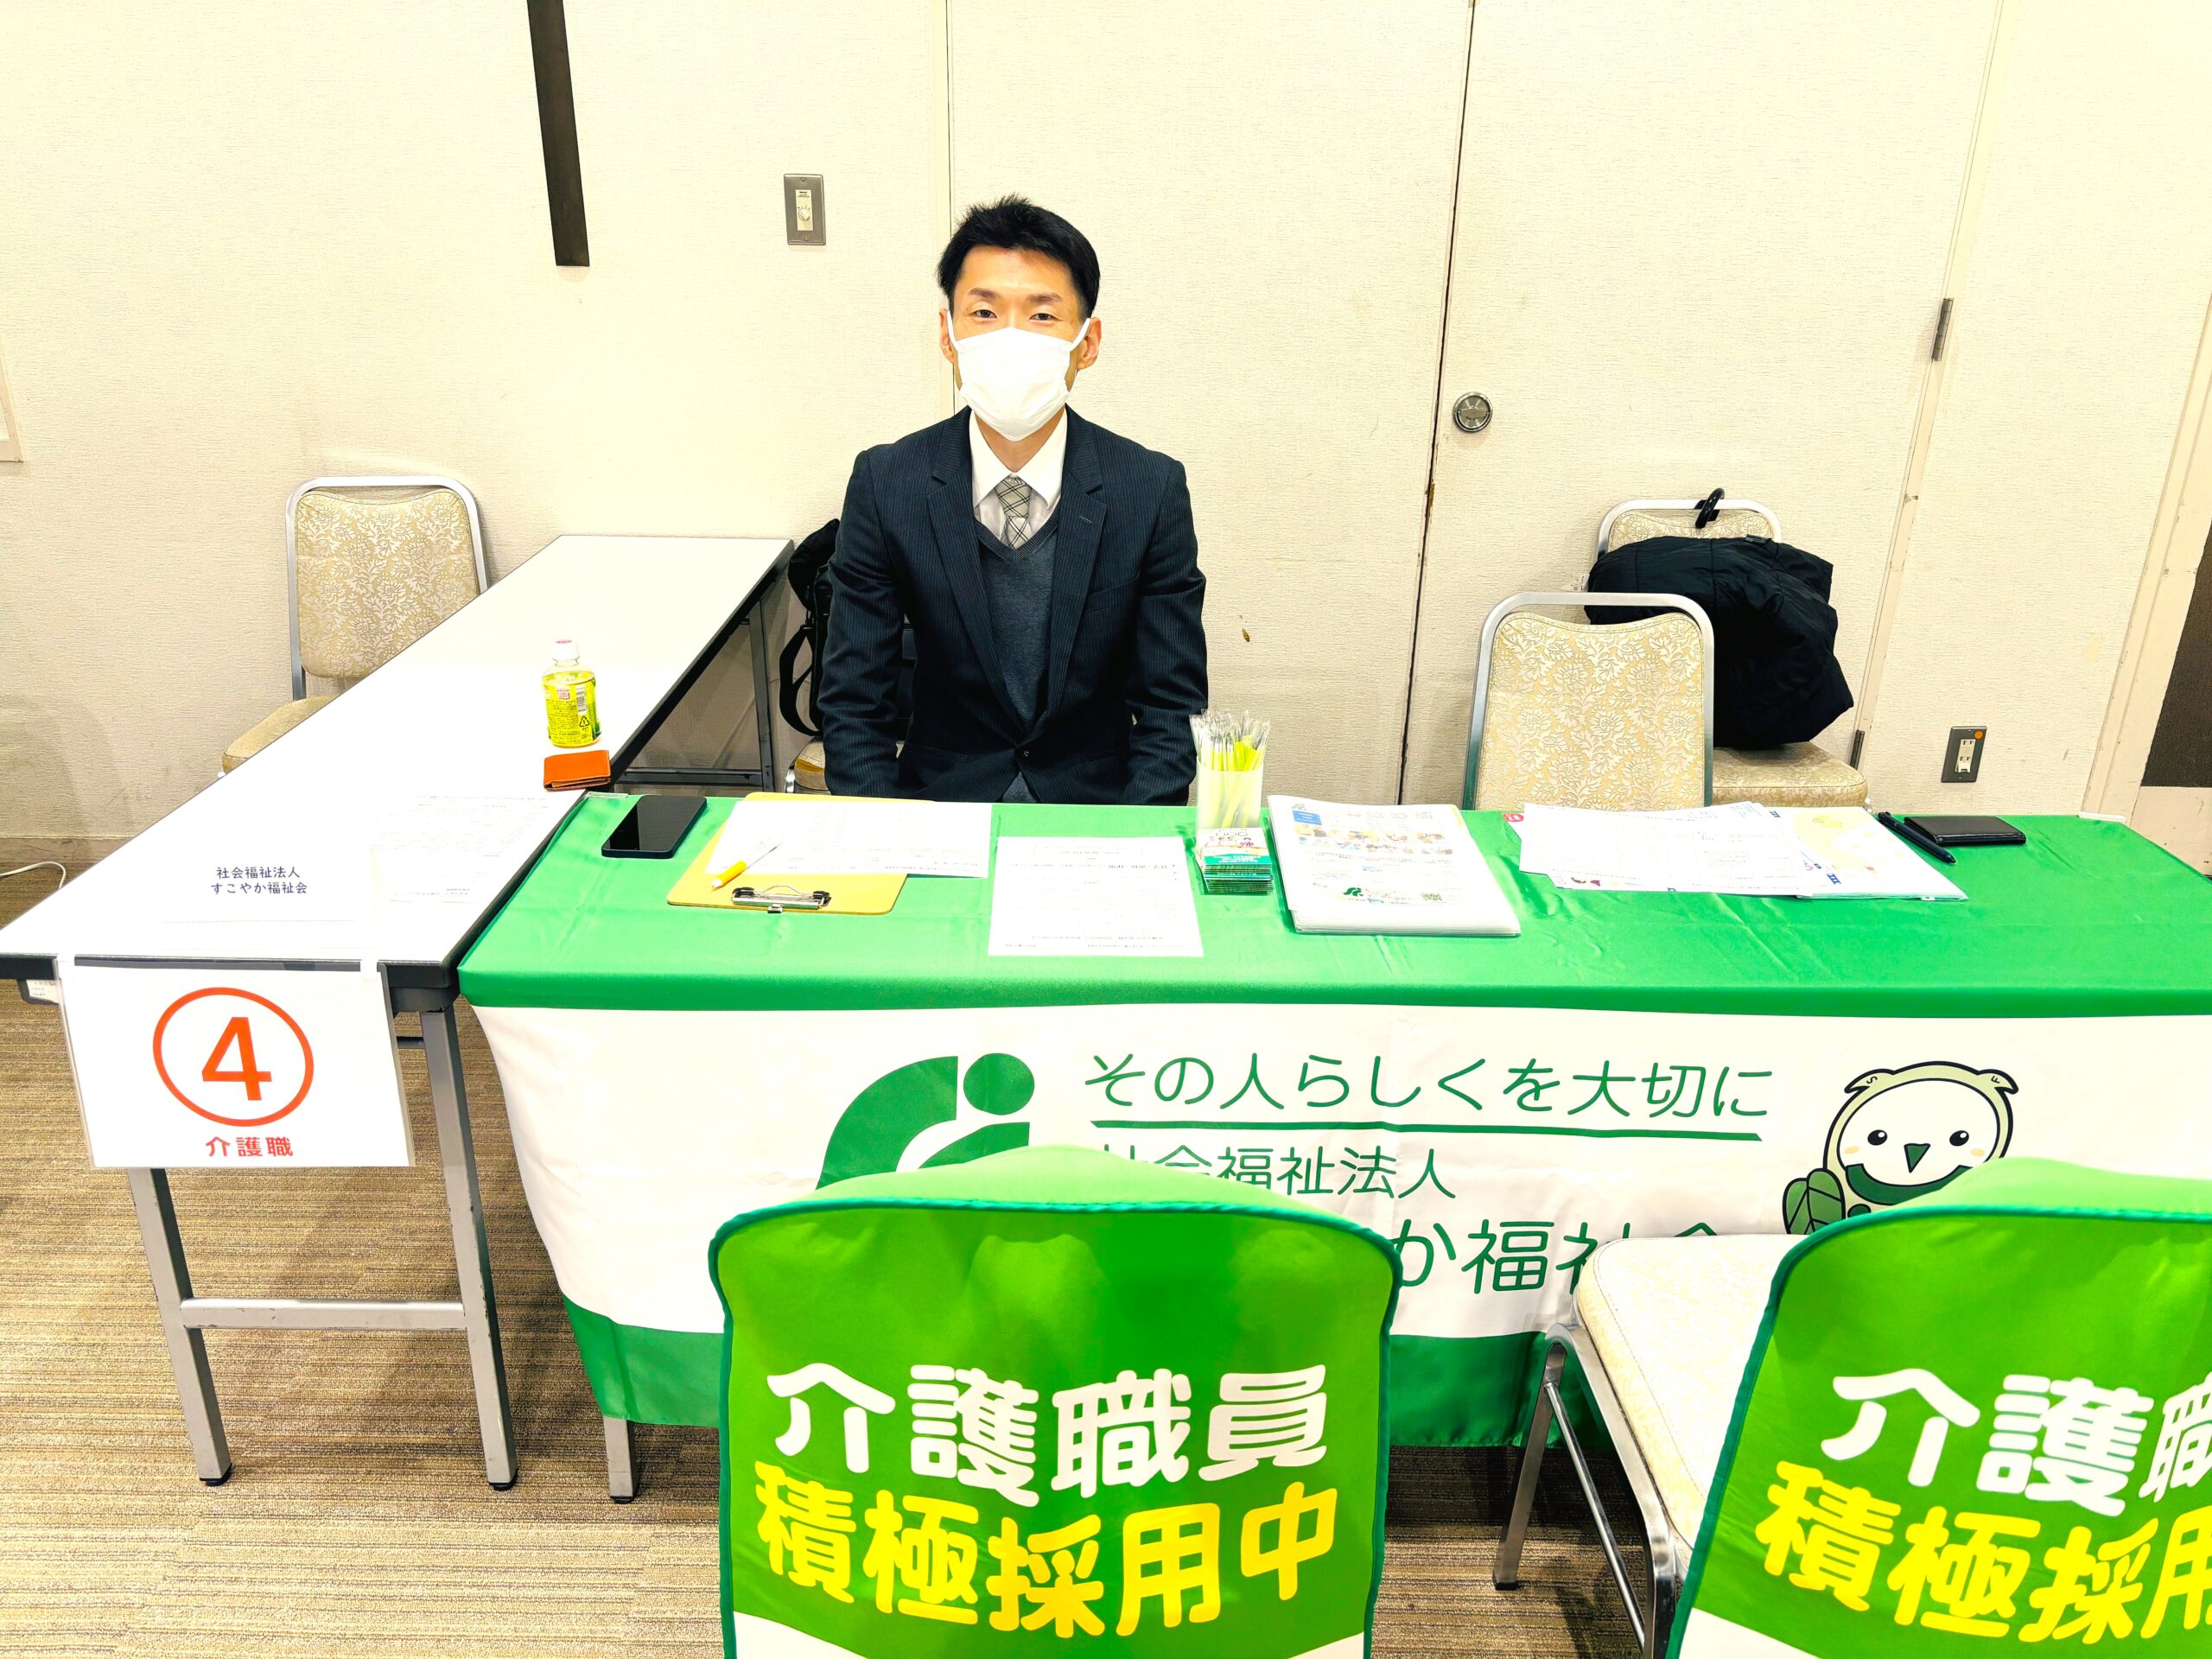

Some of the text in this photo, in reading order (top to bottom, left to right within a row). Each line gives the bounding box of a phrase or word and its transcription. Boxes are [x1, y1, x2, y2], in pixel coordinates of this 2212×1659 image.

[210, 881, 308, 895] すこやか福祉会
[216, 866, 301, 880] 社会福祉法人
[1084, 1052, 1772, 1119] その人らしくを大切に
[205, 1136, 294, 1158] 介護職
[1103, 1143, 1456, 1199] 福祉法人
[1393, 1218, 1718, 1295] か福
[766, 1363, 1327, 1508] 介護職員
[754, 1460, 1338, 1638] 積極採用中
